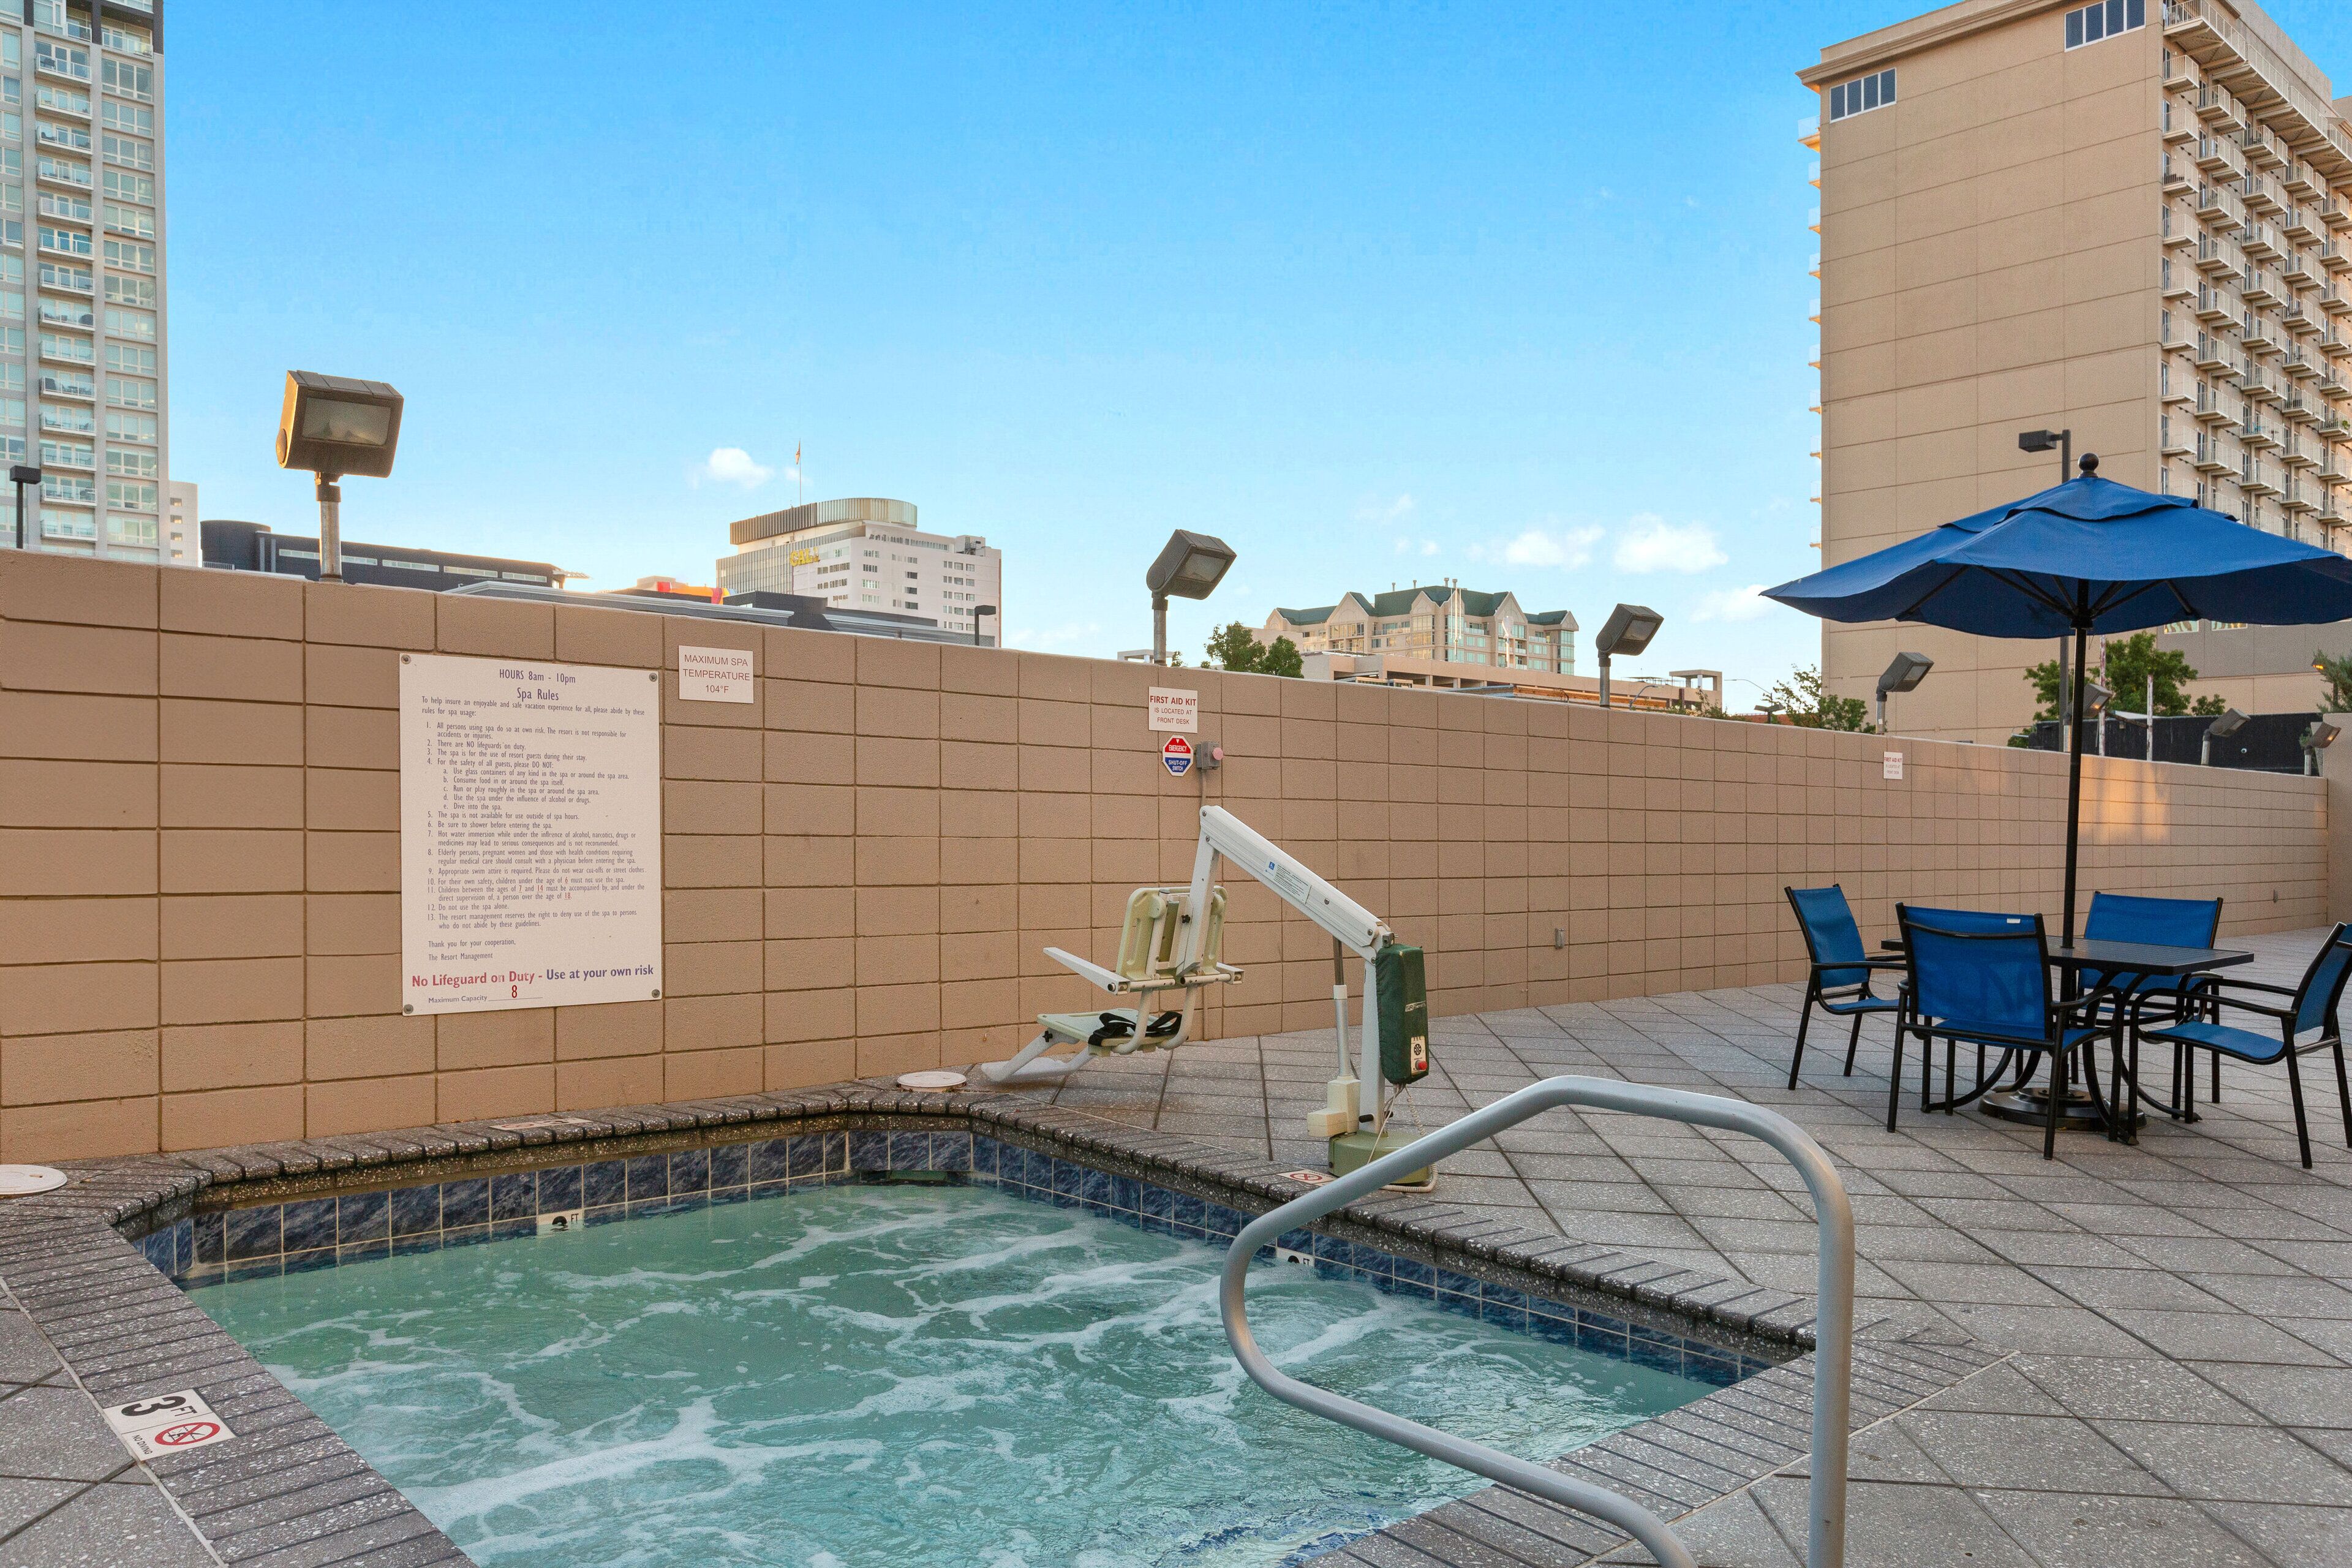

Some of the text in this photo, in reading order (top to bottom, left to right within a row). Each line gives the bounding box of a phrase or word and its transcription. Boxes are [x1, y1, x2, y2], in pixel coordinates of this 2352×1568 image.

[685, 655, 748, 666] MAXIMUM SPA
[499, 668, 524, 680] HOURS
[528, 670, 544, 681] 8am
[556, 673, 576, 685] 10pm
[683, 669, 750, 680] TEMPERATURE
[516, 687, 559, 702] Spa Rules
[431, 696, 442, 706] help
[473, 699, 497, 708] enjoyable
[547, 703, 573, 712] experience
[593, 706, 608, 714] please
[625, 707, 630, 716] by
[437, 739, 452, 747] There
[477, 741, 502, 750] lifeguards
[460, 758, 475, 767] safety
[513, 760, 529, 769] please
[508, 821, 529, 830] entering
[456, 894, 485, 902] supervision
[473, 919, 488, 928] abide
[490, 921, 497, 930] by
[460, 952, 492, 961] Management
[412, 974, 428, 987] No
[432, 971, 487, 989] Lifeguard
[490, 974, 505, 983] on
[508, 970, 535, 986] Duty
[546, 968, 565, 980] Use
[568, 968, 580, 979] at
[582, 969, 607, 981] your
[610, 968, 631, 977] own
[635, 963, 654, 975] risk
[461, 994, 487, 1003] Capacity
[511, 984, 517, 998] 8
[121, 1396, 197, 1416] 3 FT
[137, 1441, 153, 1454] DIVING
